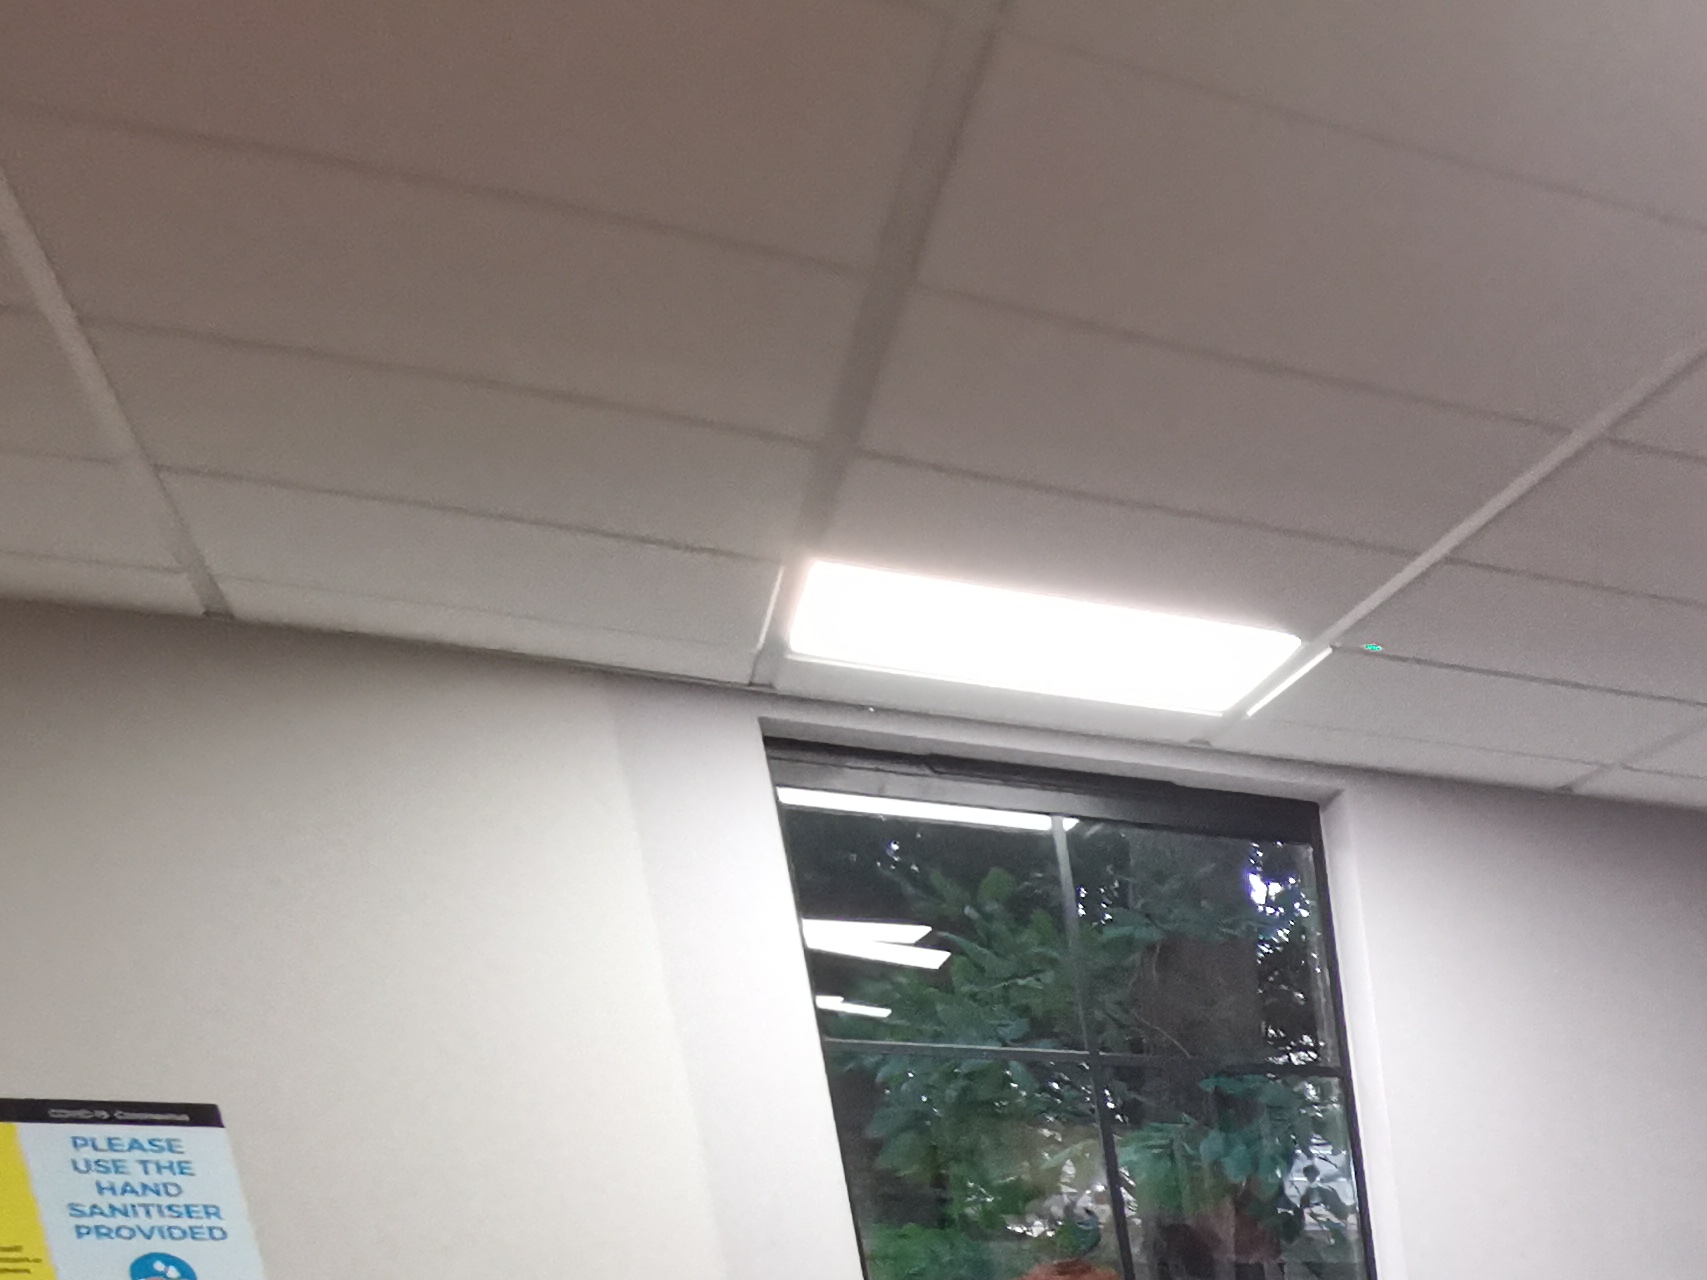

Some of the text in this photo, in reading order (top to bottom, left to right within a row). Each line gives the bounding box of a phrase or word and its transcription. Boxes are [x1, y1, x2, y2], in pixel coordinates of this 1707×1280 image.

[70, 1135, 186, 1154] PLEASE
[70, 1157, 196, 1177] USE THE
[95, 1180, 183, 1198] HAND
[66, 1202, 224, 1220] SANITISER
[74, 1224, 228, 1241] PROVIDED
